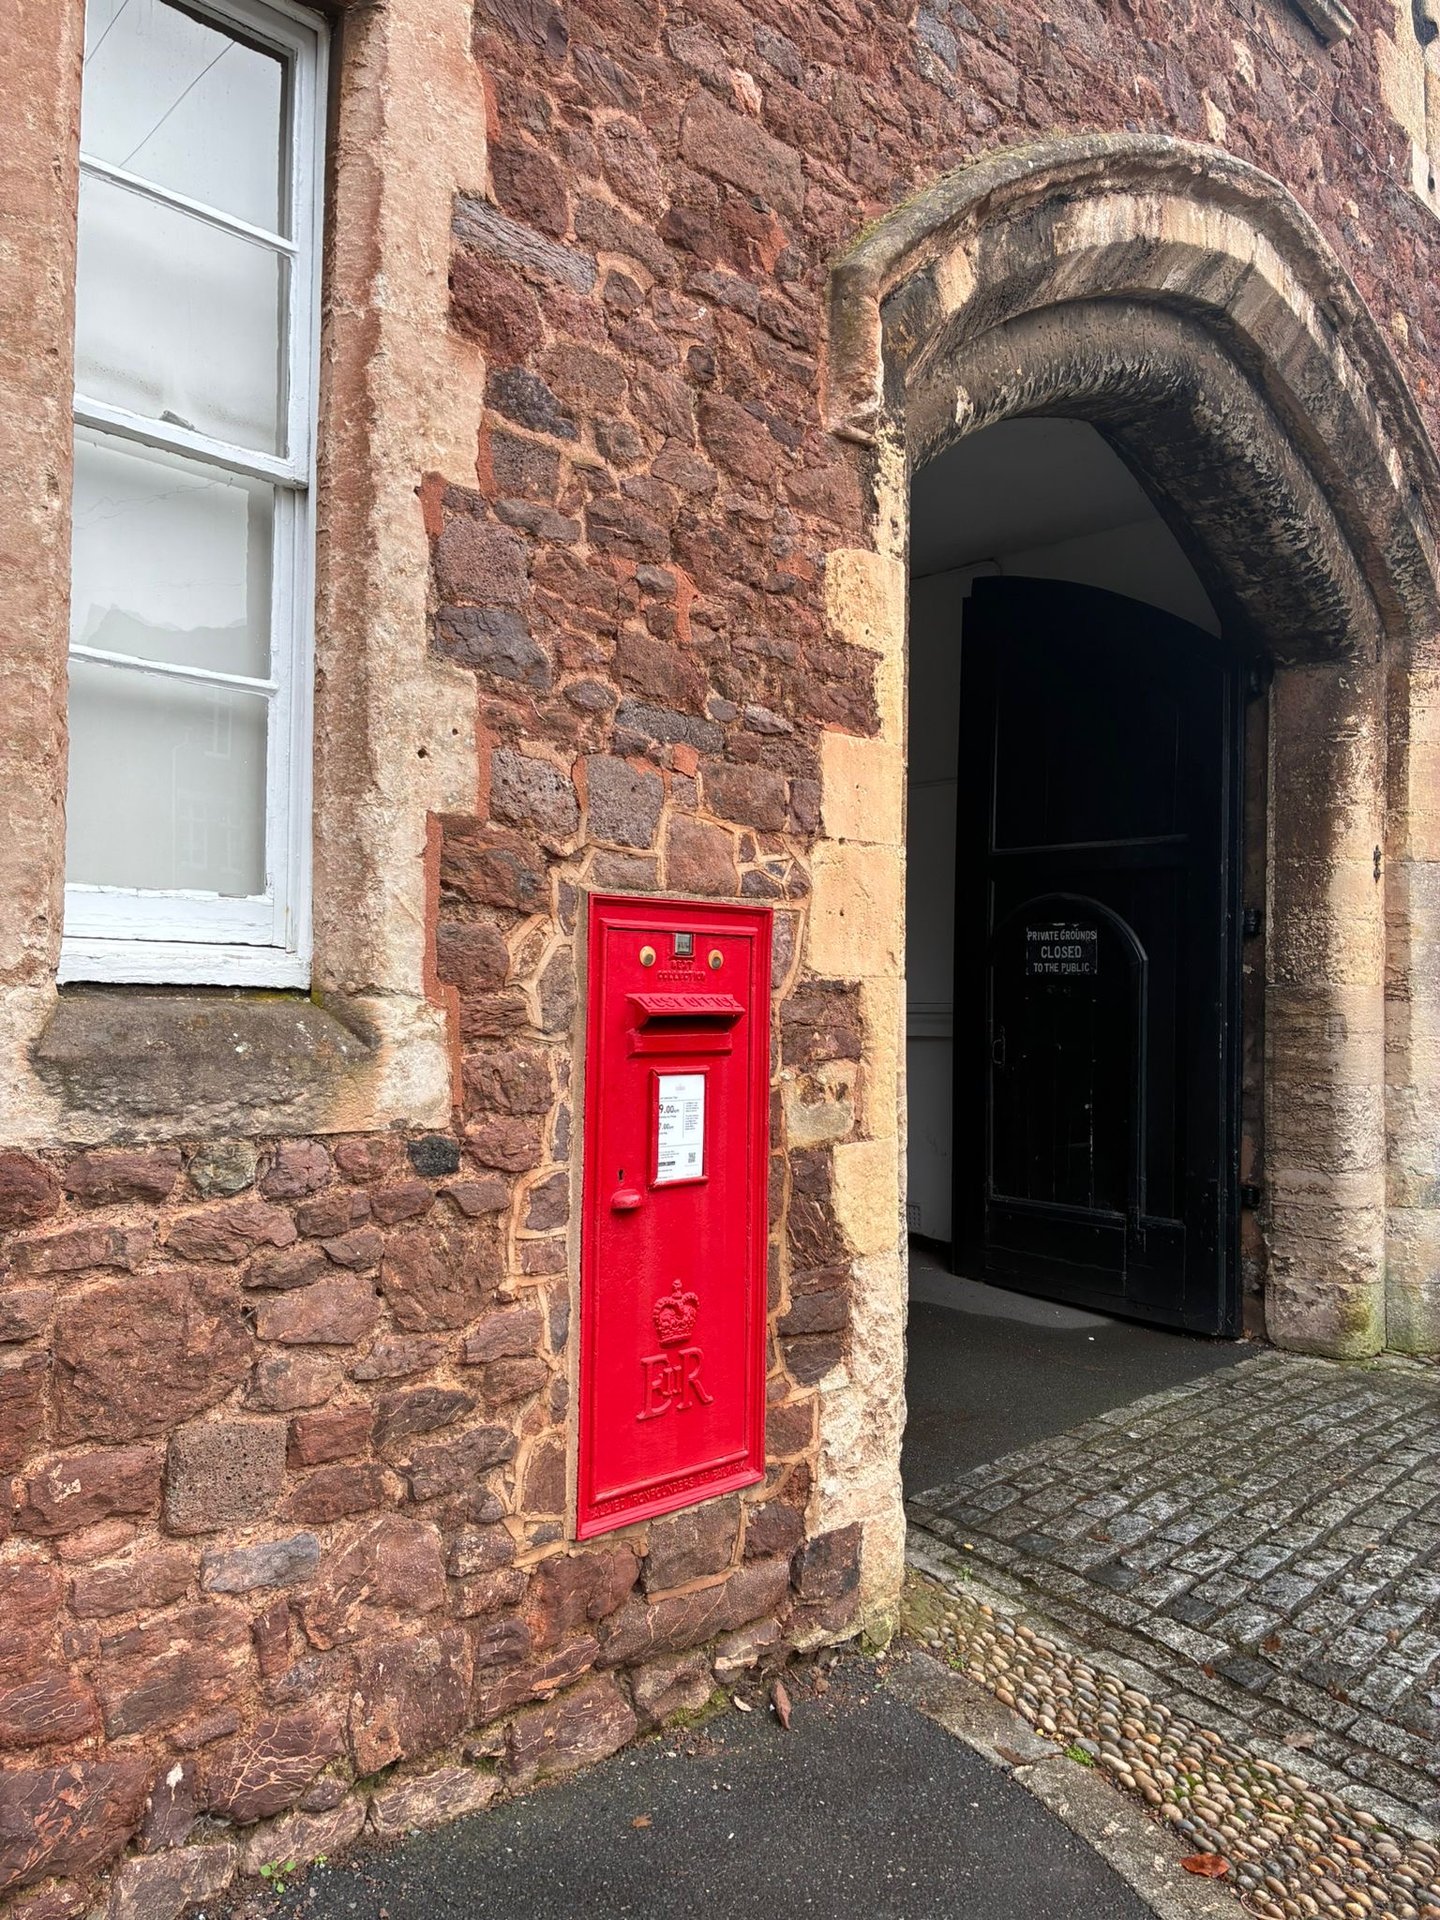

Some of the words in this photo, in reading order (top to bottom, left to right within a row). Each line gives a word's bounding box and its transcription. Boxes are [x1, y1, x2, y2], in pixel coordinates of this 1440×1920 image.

[1027, 930, 1059, 940] PRIVATE
[1060, 929, 1097, 940] GROUNDS
[1041, 945, 1082, 959] CLOSED
[1034, 962, 1043, 972] TO
[1044, 962, 1059, 972] THE
[1061, 962, 1090, 972] PUBLIC
